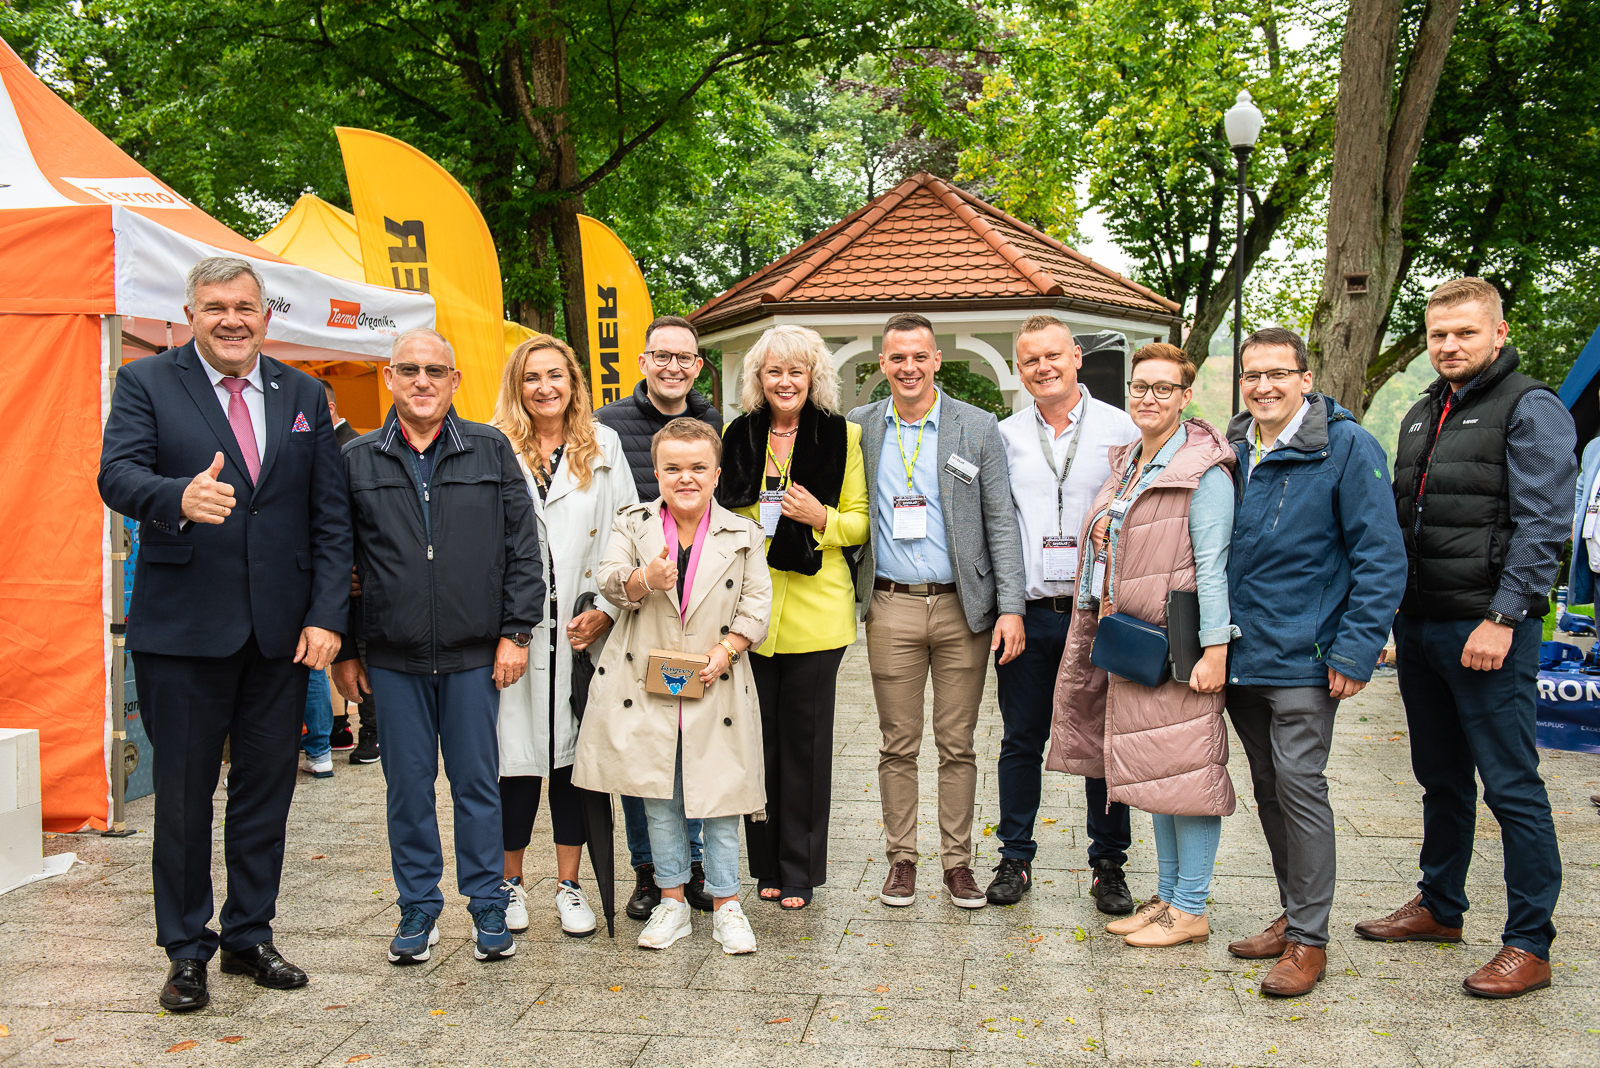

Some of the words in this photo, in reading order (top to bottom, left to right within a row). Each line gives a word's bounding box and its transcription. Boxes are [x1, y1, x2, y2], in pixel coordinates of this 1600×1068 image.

[84, 186, 175, 204] Termo
[266, 296, 291, 313] nika
[330, 307, 356, 325] Termo
[357, 312, 396, 331] Organika
